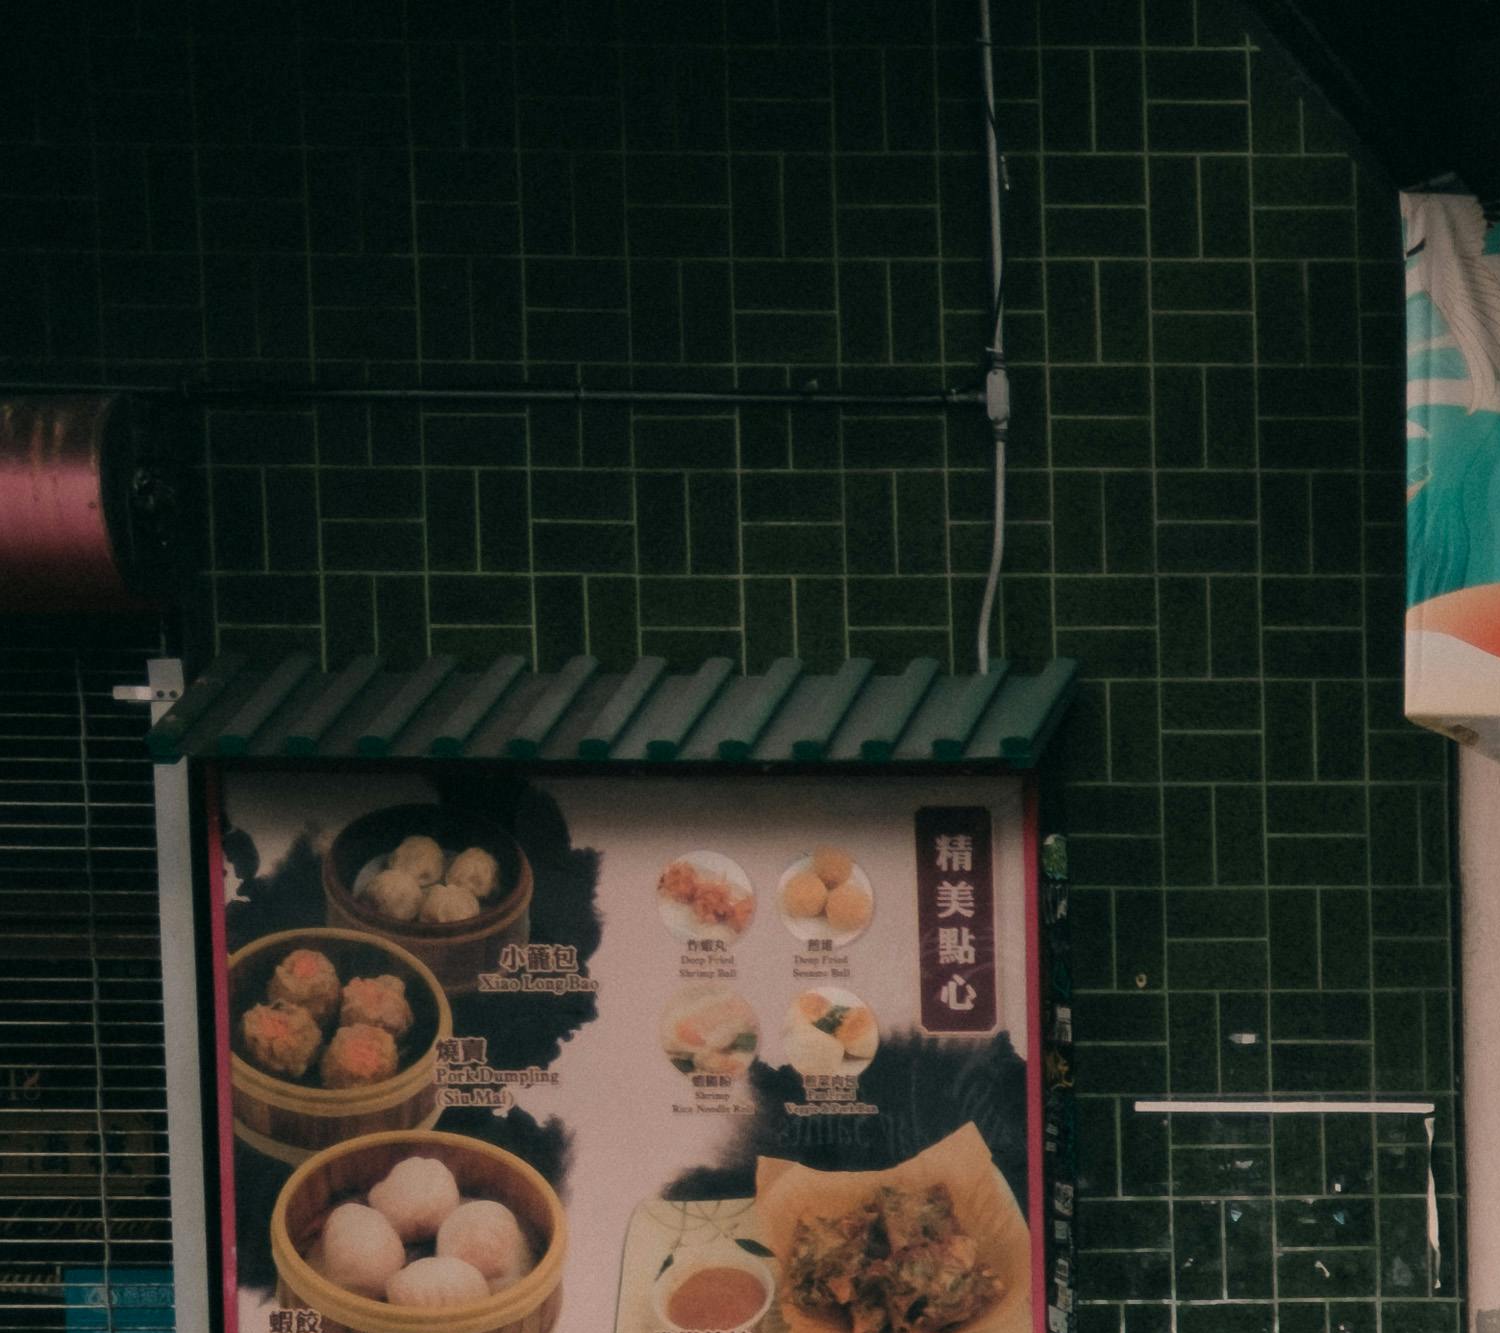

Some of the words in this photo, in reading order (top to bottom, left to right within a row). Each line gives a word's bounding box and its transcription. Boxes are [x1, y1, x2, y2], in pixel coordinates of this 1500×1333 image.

[935, 834, 978, 1011] 精美點心
[502, 944, 578, 971] 小籠包
[481, 976, 519, 991] Xiao
[524, 975, 566, 994] Long
[570, 975, 600, 991] Bao
[436, 1068, 475, 1083] Pork
[479, 1066, 559, 1087] Dumpling
[436, 1089, 472, 1106] (Siu
[475, 1089, 514, 1106] Mai)
[268, 1311, 320, 1333] 蝦餃
